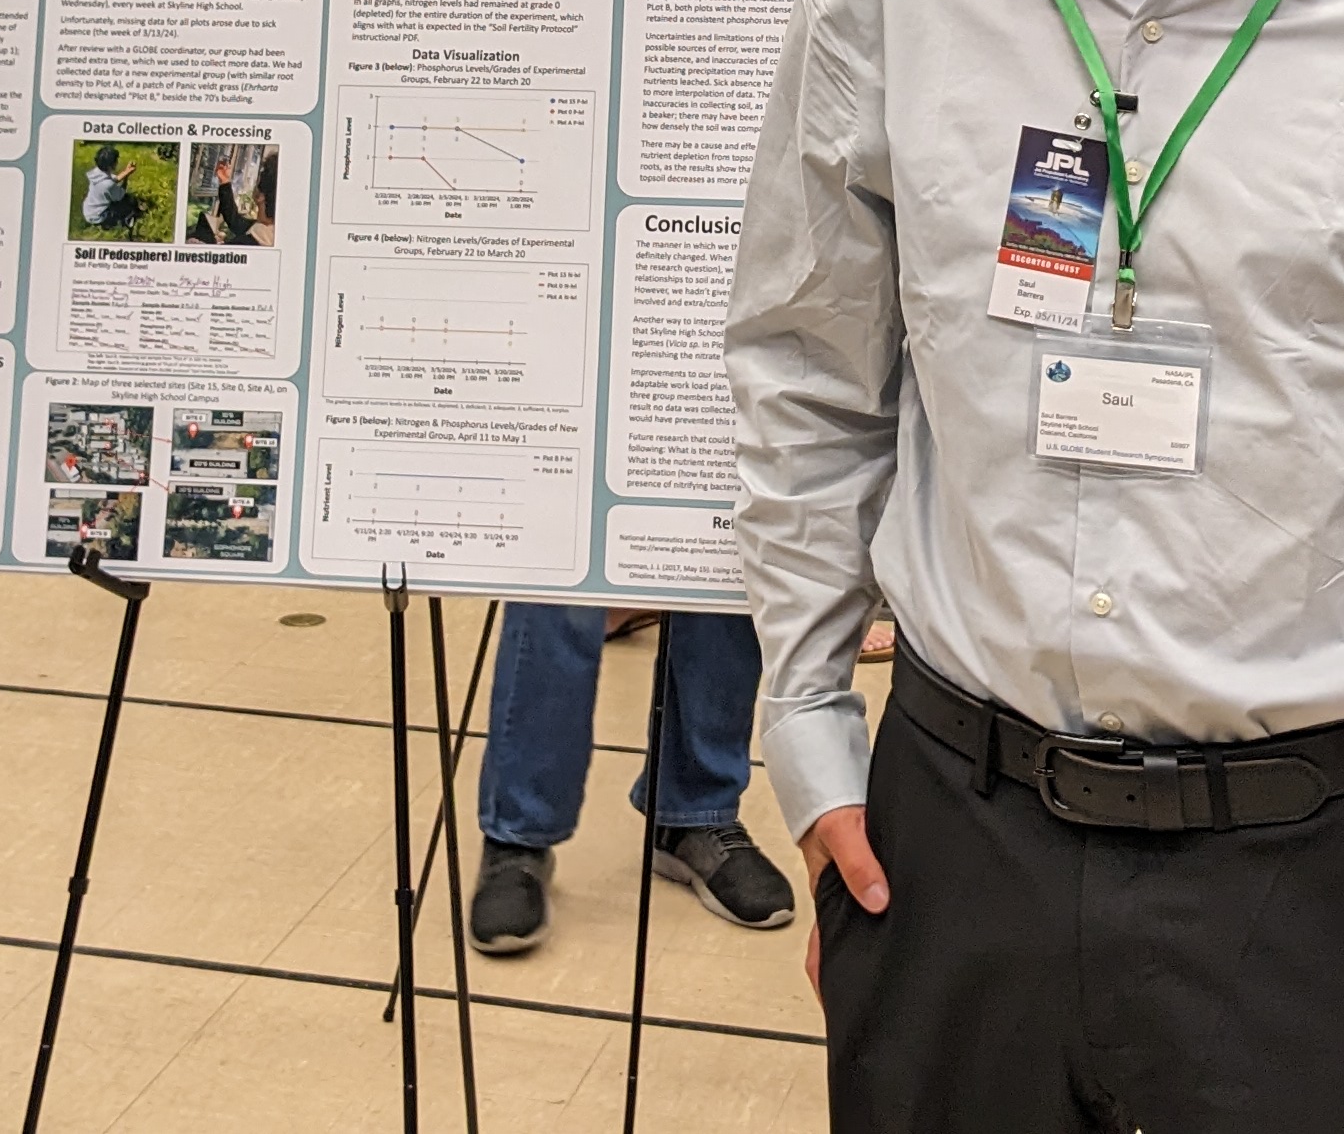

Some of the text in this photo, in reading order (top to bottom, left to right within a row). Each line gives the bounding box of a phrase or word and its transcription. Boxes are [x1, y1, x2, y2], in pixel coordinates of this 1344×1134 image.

[412, 48, 519, 61] Data Visualization
[348, 62, 373, 71] Figure
[381, 62, 415, 72] (below):
[417, 63, 463, 73] Phosphorus
[465, 64, 521, 73] Levels/Grades
[522, 65, 531, 73] of
[533, 65, 585, 75] Experimental
[400, 74, 431, 84] Groups,
[433, 75, 469, 85] February
[470, 76, 480, 84] 22
[493, 76, 518, 85] March
[520, 77, 531, 85] 20
[83, 121, 272, 140] Data Collection & Processing
[343, 138, 351, 180] Phosphorus
[1035, 151, 1090, 177] JPL
[645, 214, 742, 234] Conclusio
[74, 247, 247, 266] Soil (Pedosphere) Investigation
[1010, 253, 1080, 274] ESCORTED GUEST
[1018, 279, 1036, 289] Saul
[1017, 288, 1045, 301] Barrera
[1013, 305, 1077, 326] Exp. 05/11/24
[335, 315, 344, 348] Nitrogen
[433, 386, 452, 394] Date
[1101, 392, 1133, 407] Saul
[322, 487, 331, 522] Nutrient
[425, 550, 445, 558] Date
